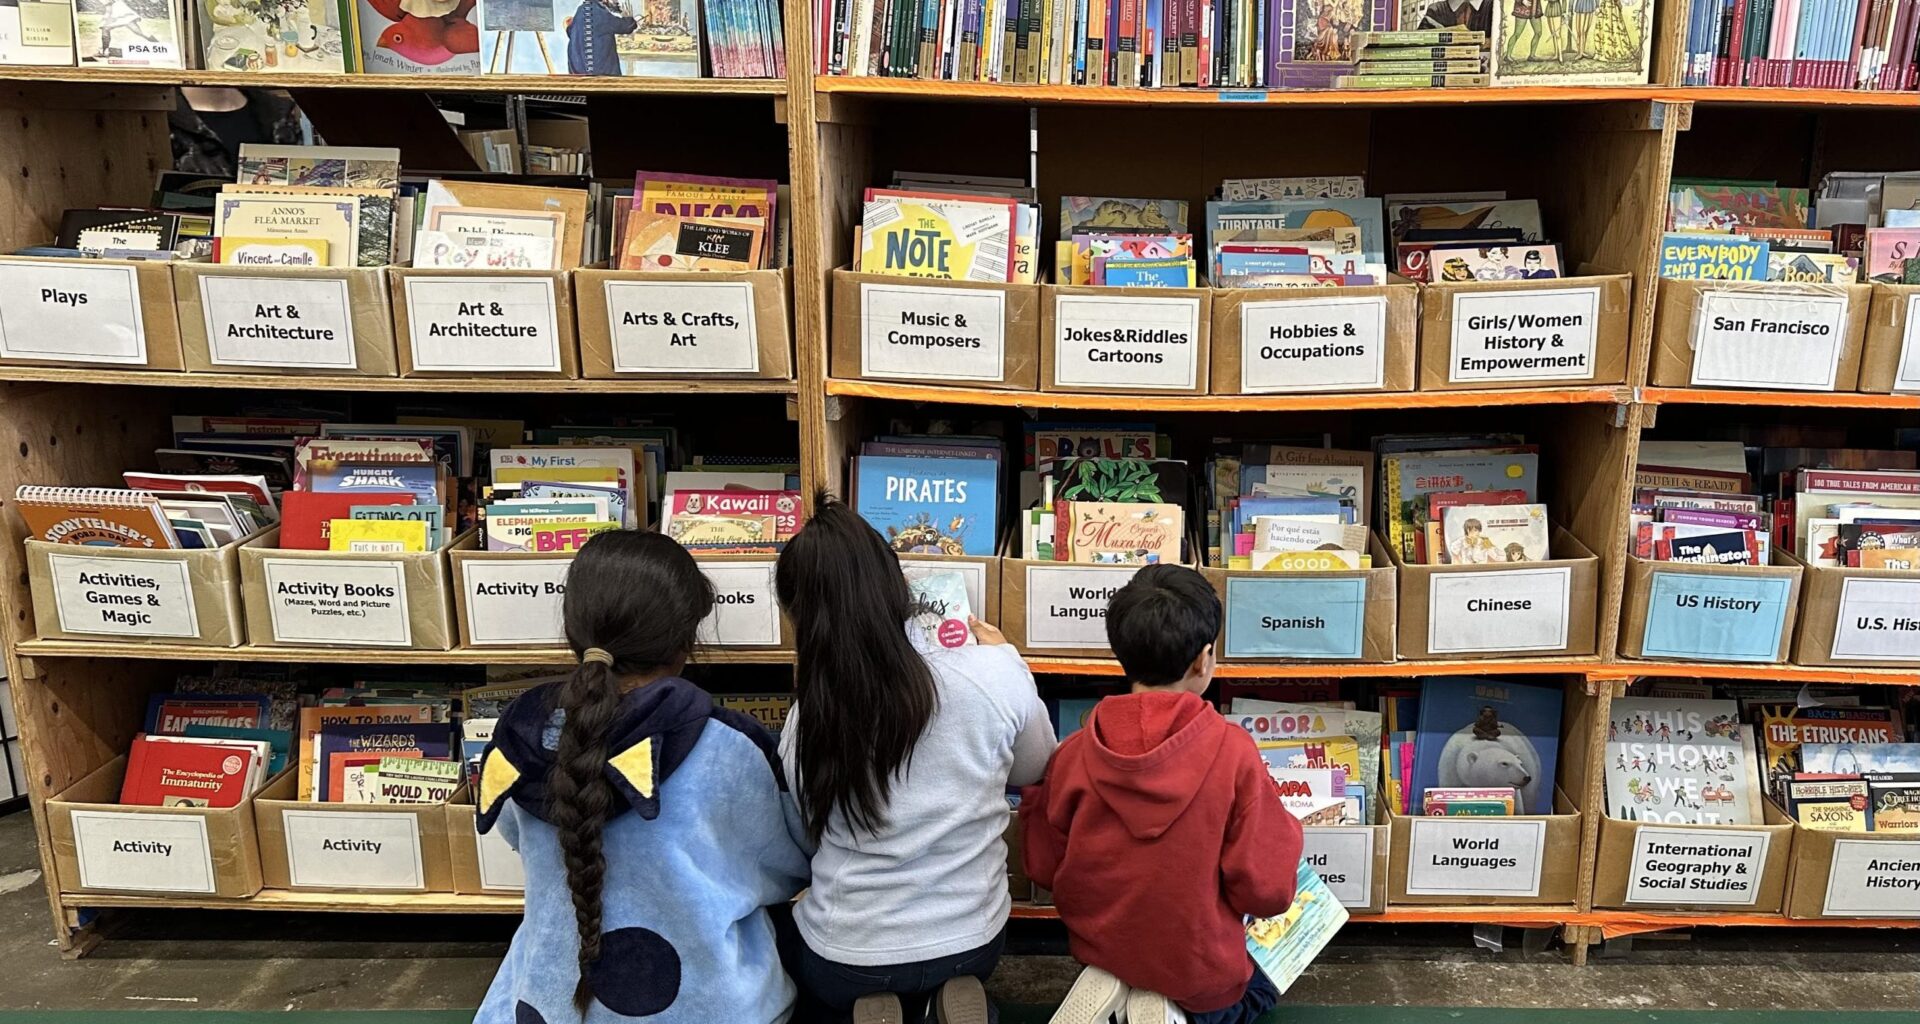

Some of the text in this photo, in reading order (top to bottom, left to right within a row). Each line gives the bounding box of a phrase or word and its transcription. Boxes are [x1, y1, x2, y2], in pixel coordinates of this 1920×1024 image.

[129, 45, 168, 53] PSA 5th
[373, 50, 394, 66] Jonah
[397, 59, 424, 72] Winter
[272, 207, 305, 216] ANNO'S
[254, 216, 320, 225] FLEA MARKET
[918, 218, 936, 228] THE
[1218, 219, 1286, 230] TURNTABLE
[722, 228, 742, 236] WORKS
[113, 237, 127, 245] The
[698, 242, 730, 255] KLEE
[434, 243, 532, 268] Play with
[886, 228, 952, 272] NOTE
[1664, 244, 1761, 265] EVERYBODY
[238, 252, 313, 265] Vincent Camille
[1136, 271, 1159, 282] The
[1663, 262, 1697, 276] INTO
[41, 288, 88, 305] Plays
[255, 304, 300, 319] Art &
[458, 302, 504, 316] Art &
[622, 311, 740, 330] Arts & Crafts,
[901, 311, 968, 328] Music &
[1467, 313, 1583, 332] Girls/Women
[1713, 316, 1830, 335] San Francisco
[227, 323, 334, 341] Architecture
[429, 322, 537, 338] Architecture
[1063, 327, 1188, 345] Jokes&Riddles
[1269, 322, 1357, 338] Hobbies &
[670, 332, 697, 347] Art
[887, 330, 981, 350] Composers
[1484, 333, 1564, 353] History &
[1087, 348, 1164, 364] Cartoons
[1260, 343, 1365, 361] Occupations
[1460, 352, 1586, 373] Empowerment
[532, 456, 576, 467] My First
[338, 475, 406, 488] SHARK
[1636, 474, 1736, 491] ROUGH READY
[1814, 479, 1911, 491] 100 TRUE TALES FROM AMERICAN
[886, 476, 968, 503] PIRATES
[706, 495, 770, 511] Kawaii
[1655, 499, 1753, 512] Your Life Private
[496, 518, 547, 526] ELEPHANT
[1748, 519, 1757, 529] 4
[44, 517, 155, 548] STORYTELLER'S
[72, 531, 96, 541] WORD
[107, 532, 128, 542] DAY
[1076, 521, 1166, 550] Михалков
[1287, 524, 1320, 536] qué estás
[536, 528, 588, 551] BFF
[1270, 533, 1322, 545] haciendo eso?
[1890, 535, 1918, 545] What's
[354, 544, 394, 552] THIS NOT
[1679, 545, 1701, 555] The
[1282, 558, 1331, 569] GOOD
[1669, 550, 1752, 564] Washington
[1884, 559, 1911, 569] The
[79, 572, 161, 590] Activities,
[277, 582, 394, 598] Activity Books
[476, 582, 539, 598] Activity
[86, 591, 161, 606] Games &
[284, 598, 316, 607] (Mazes,
[343, 600, 359, 608] and
[361, 600, 391, 608] Picture
[716, 592, 755, 605] ooks
[1467, 598, 1532, 613] Chinese
[1676, 594, 1762, 613] US History
[102, 609, 152, 626] Magic
[311, 608, 366, 618] Puzzles, etc.)
[1050, 606, 1107, 620] Langua
[1261, 615, 1326, 632] Spanish
[1857, 617, 1888, 630] U.S.
[321, 715, 412, 725] HOW TO DRAW
[1635, 709, 1702, 734] THIS
[1807, 709, 1885, 720] BACK BASICS
[1240, 714, 1327, 734] COLORA
[349, 734, 416, 748] THE WIZARD'S
[1770, 724, 1889, 743] THE ETRUSCANS
[1620, 742, 1727, 766] IS HOW
[176, 770, 216, 779] Encyclopedia
[161, 775, 223, 792] Immaturity
[1654, 777, 1699, 800] WE
[1795, 784, 1864, 796] HORRIBLE HISTORIES
[382, 783, 452, 800] WOULD YOU
[1642, 810, 1687, 824] DO
[1810, 811, 1854, 822] SAXONS
[1879, 820, 1919, 829] Warriors
[113, 840, 172, 857] Activity
[322, 839, 382, 854] Activity
[1452, 838, 1500, 850] World
[1647, 842, 1753, 858] International
[1306, 854, 1327, 866] rld
[1432, 854, 1517, 869] Languages
[1645, 860, 1748, 876] Geography &
[1639, 877, 1748, 891] Social Studies
[1866, 877, 1920, 891] History
